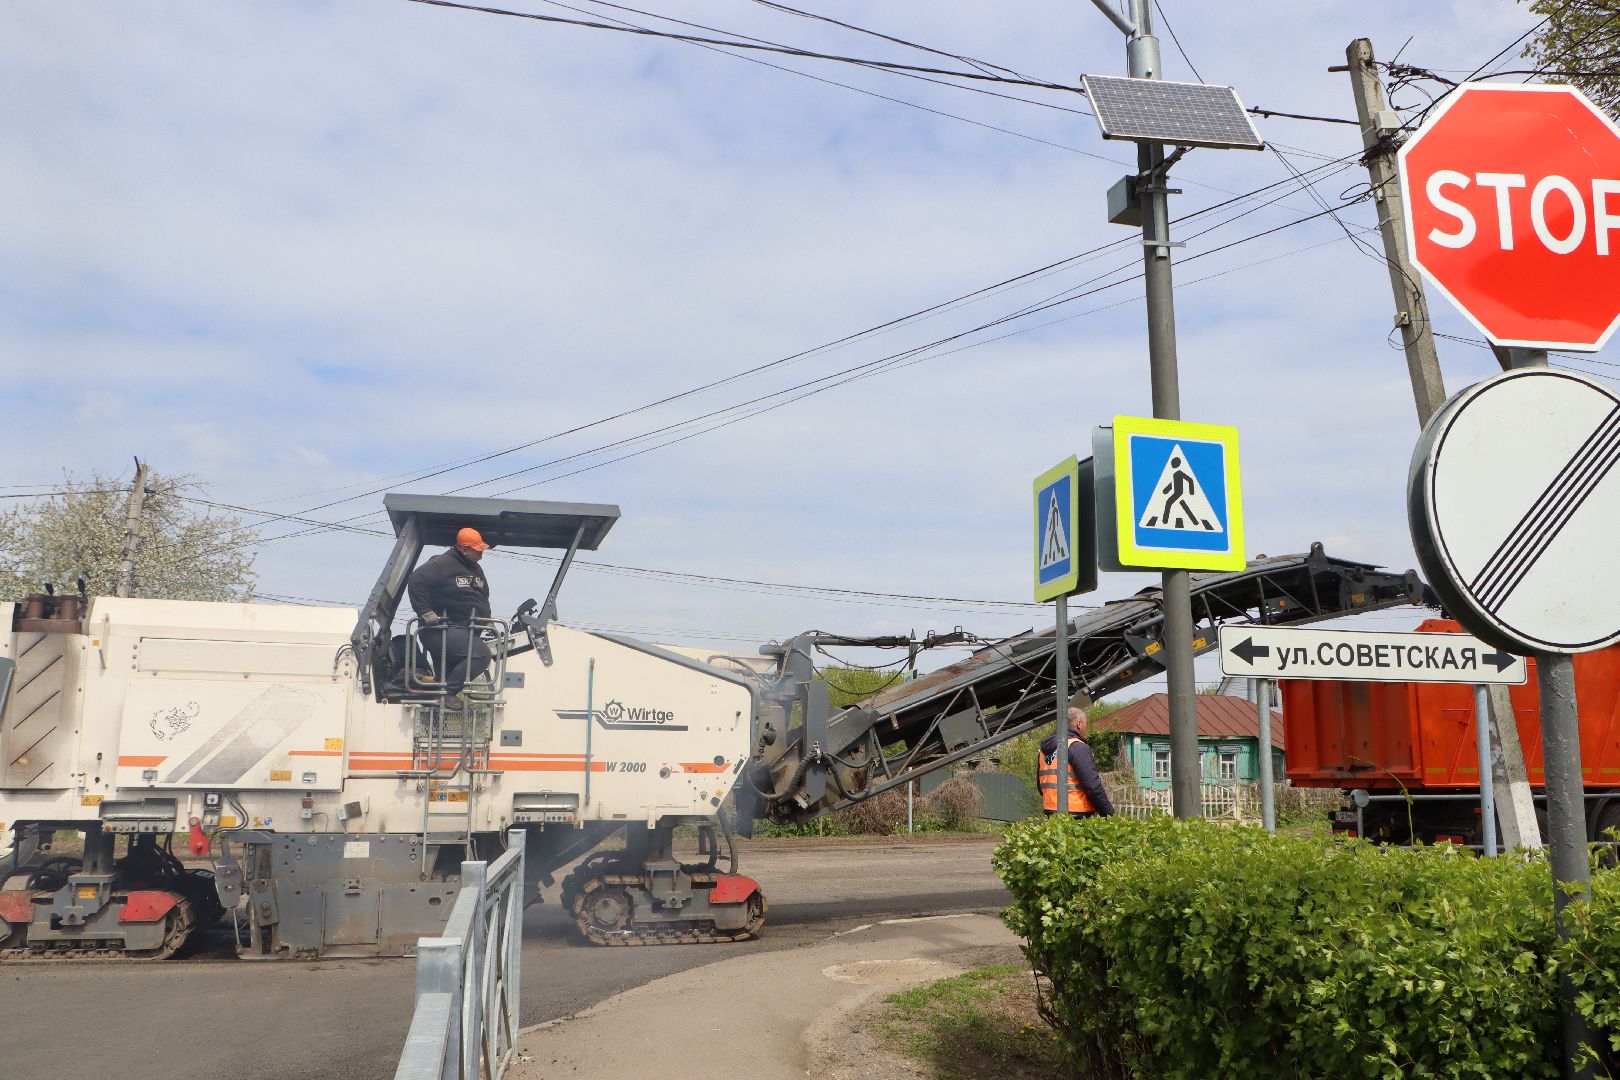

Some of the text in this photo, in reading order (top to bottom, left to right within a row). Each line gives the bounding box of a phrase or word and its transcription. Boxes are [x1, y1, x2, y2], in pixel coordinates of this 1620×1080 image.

[1276, 642, 1477, 671] ул.СОВЕТСКАЯ
[626, 707, 674, 725] Wirtge
[606, 761, 647, 773] W 2000
